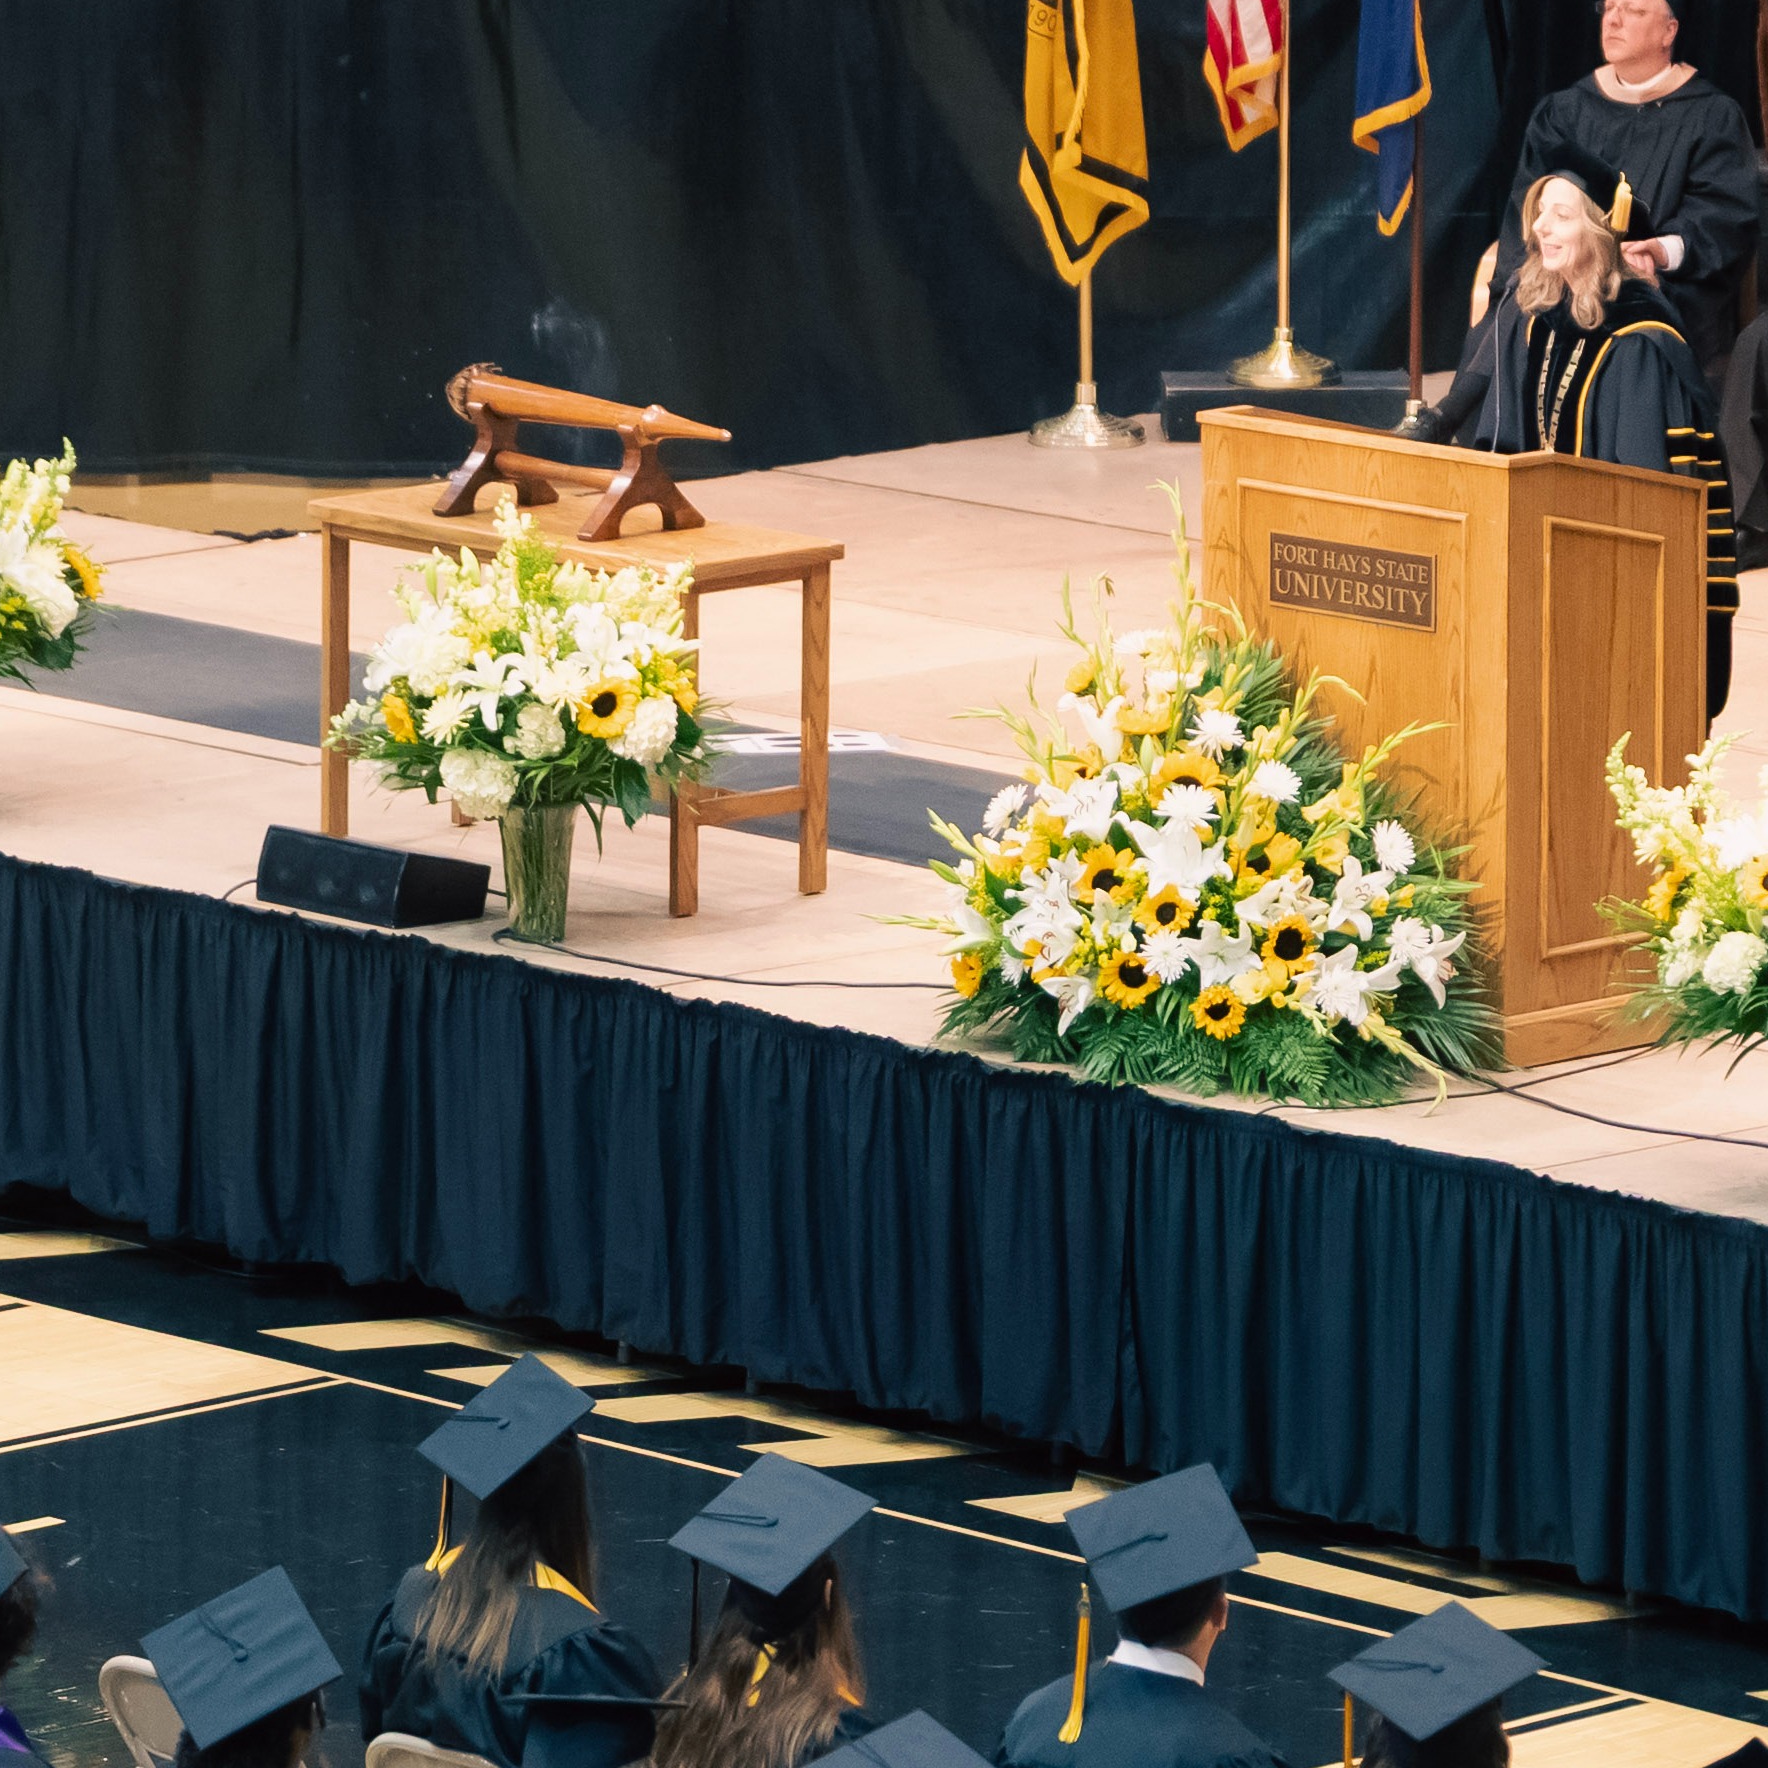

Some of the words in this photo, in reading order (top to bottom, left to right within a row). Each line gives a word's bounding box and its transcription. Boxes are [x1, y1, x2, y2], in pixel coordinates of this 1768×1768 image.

[1273, 542, 1319, 567] FORT
[1323, 551, 1371, 575] HAYS
[1376, 559, 1429, 584] STATE
[1274, 568, 1428, 616] UNIVERSITY
